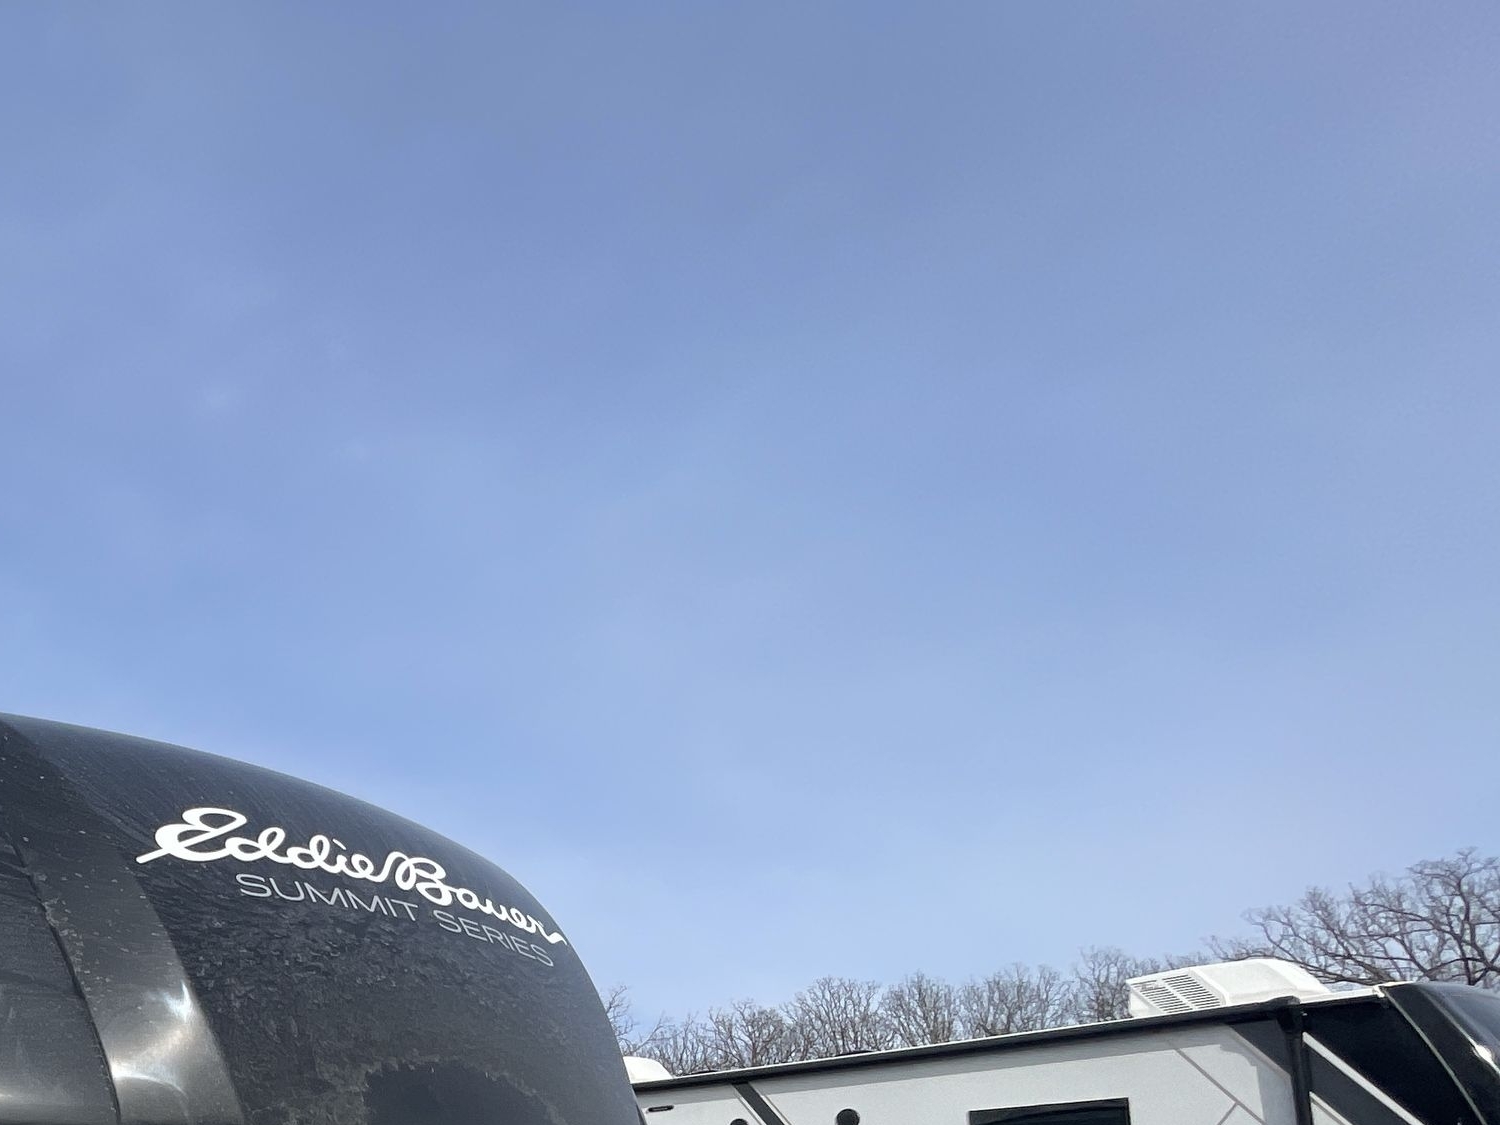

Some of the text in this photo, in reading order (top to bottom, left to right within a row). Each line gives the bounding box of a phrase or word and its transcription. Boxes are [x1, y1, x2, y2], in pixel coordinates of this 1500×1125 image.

[136, 806, 568, 945] Eddie Bauer
[235, 872, 555, 968] SUMMIT SERIES
